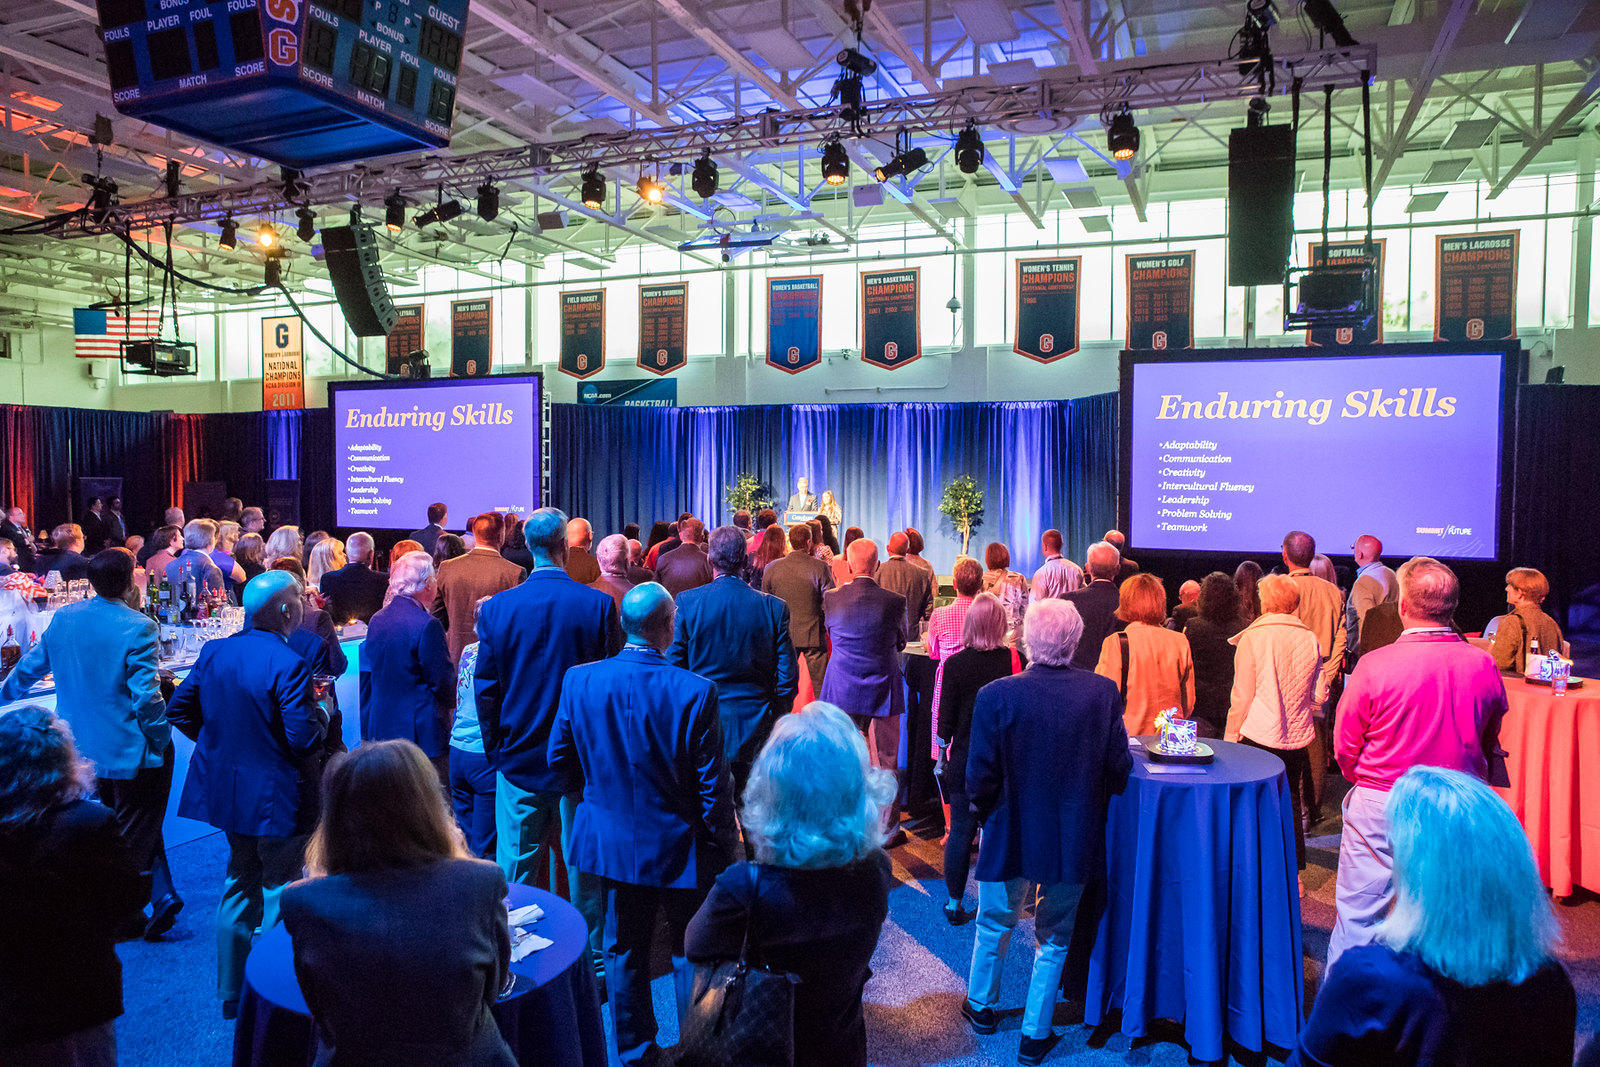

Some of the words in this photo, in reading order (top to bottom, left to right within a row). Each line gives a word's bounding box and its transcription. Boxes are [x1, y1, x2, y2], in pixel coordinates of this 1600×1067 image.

[227, 0, 257, 12] FOULS
[375, 1, 382, 10] P
[189, 8, 213, 20] FOUL
[309, 4, 339, 27] FOULS
[428, 5, 460, 31] GUEST
[147, 15, 180, 31] PLAYER
[104, 27, 130, 41] FOULS
[376, 22, 404, 43] BONUS
[269, 28, 298, 66] G
[359, 29, 392, 53] PLAYER
[401, 50, 420, 68] FOUL
[235, 62, 265, 77] SCORE
[179, 75, 207, 89] MATCH
[302, 66, 334, 88] SCORE
[434, 67, 457, 86] FOULS
[113, 88, 141, 102] SCORE
[357, 90, 385, 110] MATCH
[424, 119, 449, 137] SCORE
[1443, 242, 1468, 251] MEN'S
[1469, 239, 1511, 249] LACROSSE
[1328, 248, 1365, 258] SOFTBALL
[1443, 248, 1512, 263] CHAMPIONS
[1023, 264, 1051, 273] WOMEN'S
[1052, 263, 1075, 271] TENNIS
[1136, 260, 1166, 269] WOMEN'S
[1168, 259, 1184, 267] GOLF
[883, 275, 914, 283] BASKETBALL
[1022, 272, 1075, 284] CHAMPIONS
[1133, 267, 1190, 280] CHAMPIONS
[792, 282, 818, 290] BASKETBALL
[867, 283, 915, 295] CHAMPIONS
[643, 296, 683, 306] CHAMPIONS
[772, 290, 817, 301] CHAMPIONS
[564, 302, 601, 312] CHAMPIONS
[454, 311, 489, 321] CHAMPIONS
[1466, 319, 1484, 339] G
[275, 323, 289, 349] G
[1152, 331, 1167, 350] G
[1040, 333, 1054, 353] G
[788, 347, 799, 364] G
[885, 342, 898, 360] G
[577, 354, 588, 370] G
[657, 349, 668, 366] G
[268, 360, 298, 371] NATIONAL
[466, 360, 477, 375] G
[265, 371, 301, 381] CHAMPIONS
[272, 393, 295, 407] 2011
[1155, 390, 1333, 426] Enduring
[1341, 387, 1457, 418] Skills
[345, 405, 446, 432] Enduring
[450, 402, 514, 427] Skills
[350, 443, 382, 453] Adaptability
[1162, 440, 1218, 451] Adaptability
[350, 454, 391, 462] Communication
[1162, 454, 1232, 464] Communication
[350, 465, 376, 474] Creativity
[1162, 467, 1206, 479] Creativity
[350, 475, 383, 483] Intercultural
[383, 475, 404, 485] Fluency
[350, 486, 379, 495] Leadership
[1161, 481, 1218, 491] Intercultural
[1219, 482, 1255, 493] Fluency
[350, 496, 372, 504] Problem
[372, 496, 392, 506] Solving
[1161, 495, 1210, 506] Leadership
[350, 507, 378, 515] Teamwork
[1161, 508, 1197, 518] Problem
[1198, 509, 1233, 521] Solving
[1161, 522, 1208, 532] Teamwork
[1448, 527, 1472, 536] FUTURE
